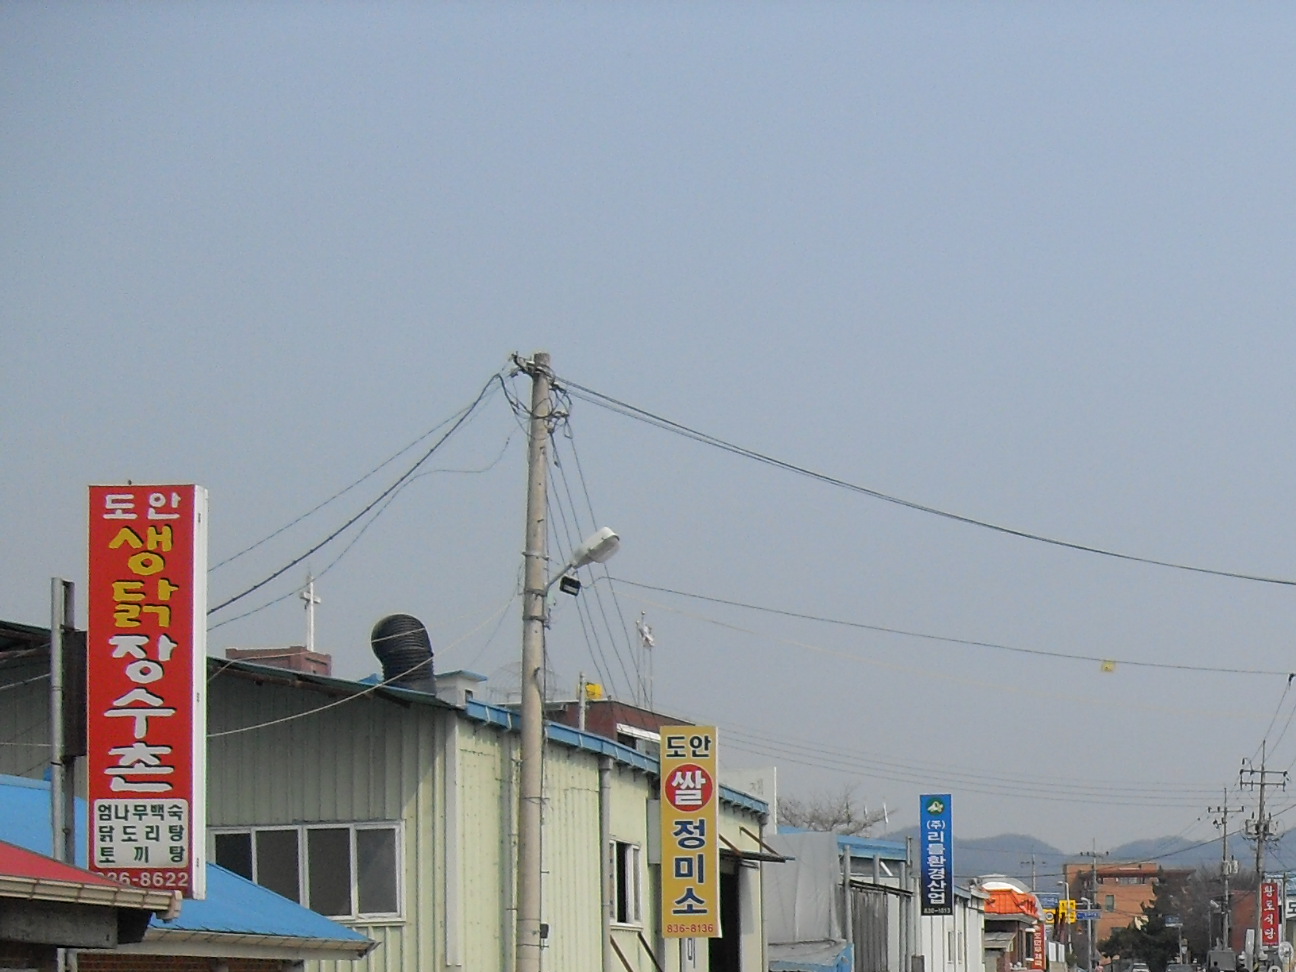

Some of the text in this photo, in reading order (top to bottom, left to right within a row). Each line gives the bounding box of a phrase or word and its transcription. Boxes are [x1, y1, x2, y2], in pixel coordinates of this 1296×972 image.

[103, 492, 181, 521] 도안
[103, 524, 178, 793] 생닭 장수촌
[665, 735, 711, 758] 도안
[671, 770, 706, 806] 쌀
[97, 803, 184, 822] 엄나무백숙
[98, 824, 185, 842] 닭도리탕
[672, 820, 708, 914] 정미소
[666, 923, 714, 933] 836-8136
